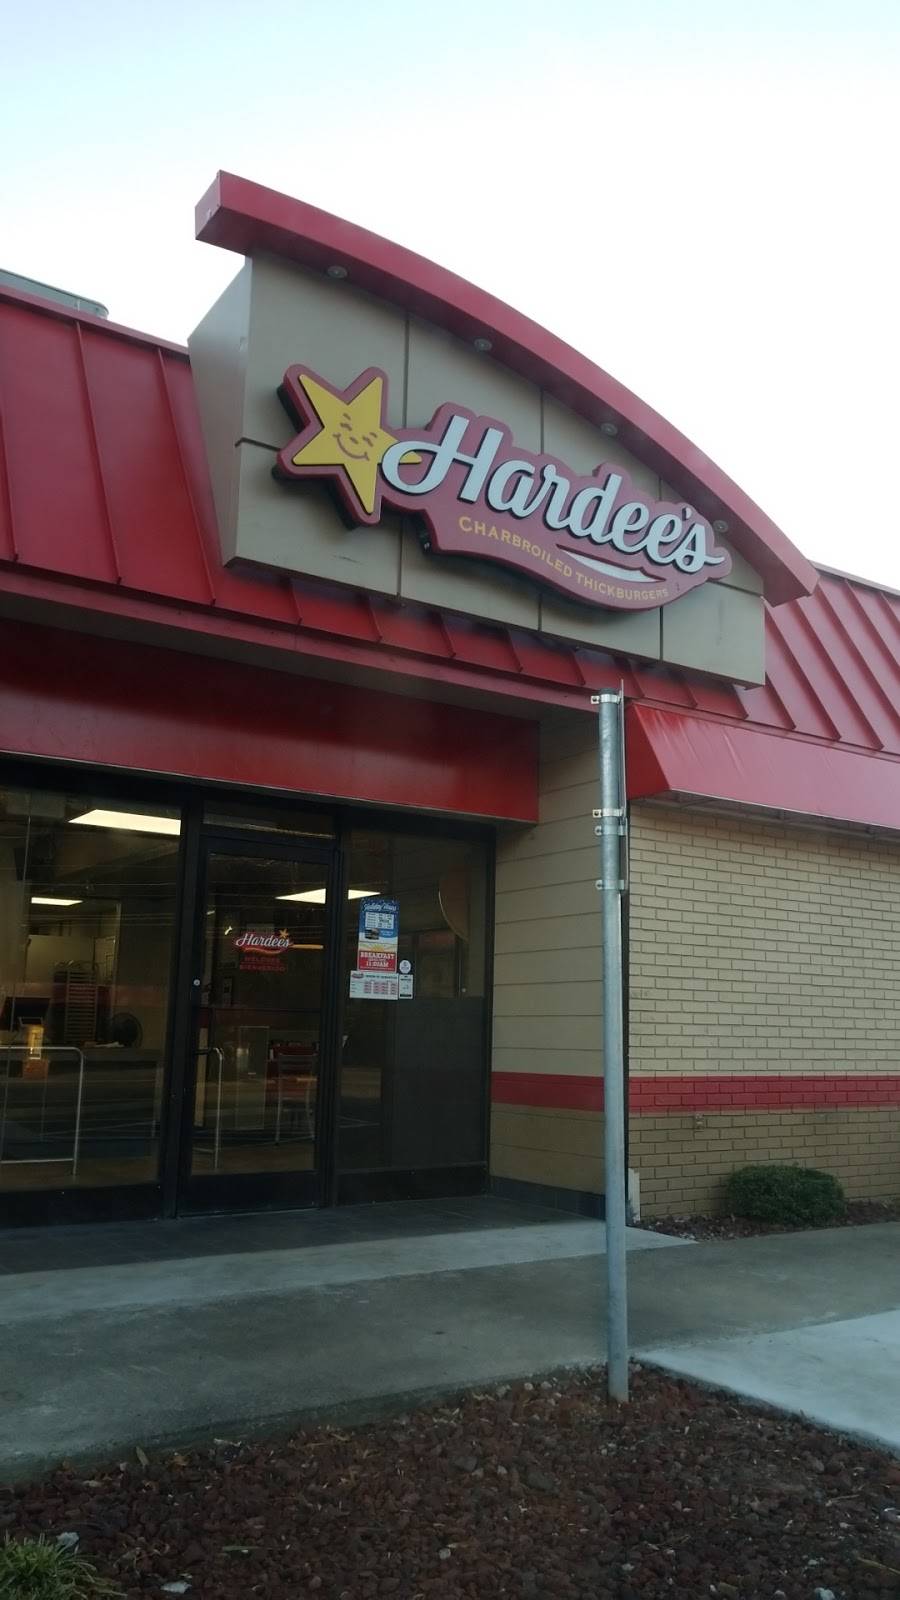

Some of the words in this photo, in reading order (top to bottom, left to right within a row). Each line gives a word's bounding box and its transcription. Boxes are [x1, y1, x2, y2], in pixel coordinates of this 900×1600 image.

[382, 415, 725, 574] Hardee's
[458, 516, 572, 577] CHARBROILED
[575, 571, 669, 599] THICKBURGERS
[360, 952, 395, 960] BREAKFAST
